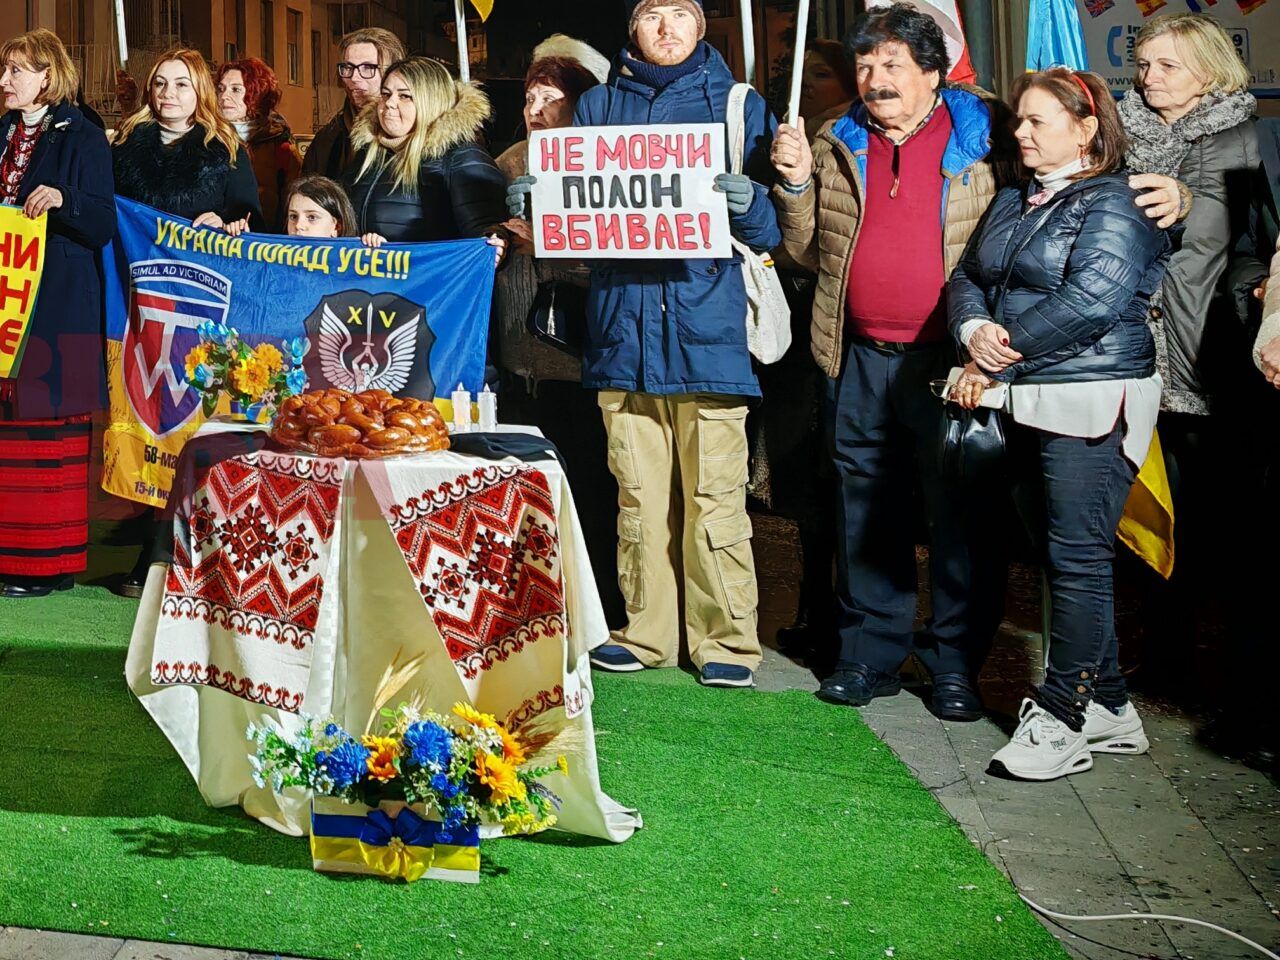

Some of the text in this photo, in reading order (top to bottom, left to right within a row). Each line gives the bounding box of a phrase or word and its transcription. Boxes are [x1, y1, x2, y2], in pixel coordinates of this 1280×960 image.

[540, 133, 712, 172] НЕ МОВЧИ
[562, 173, 683, 209] ПОЛОН
[542, 212, 712, 251] ВБИВАЕ!
[247, 241, 334, 275] ПОНАД
[337, 246, 412, 280] УСЕ!!!
[132, 266, 228, 295] SIMUL AD VICTORIAM
